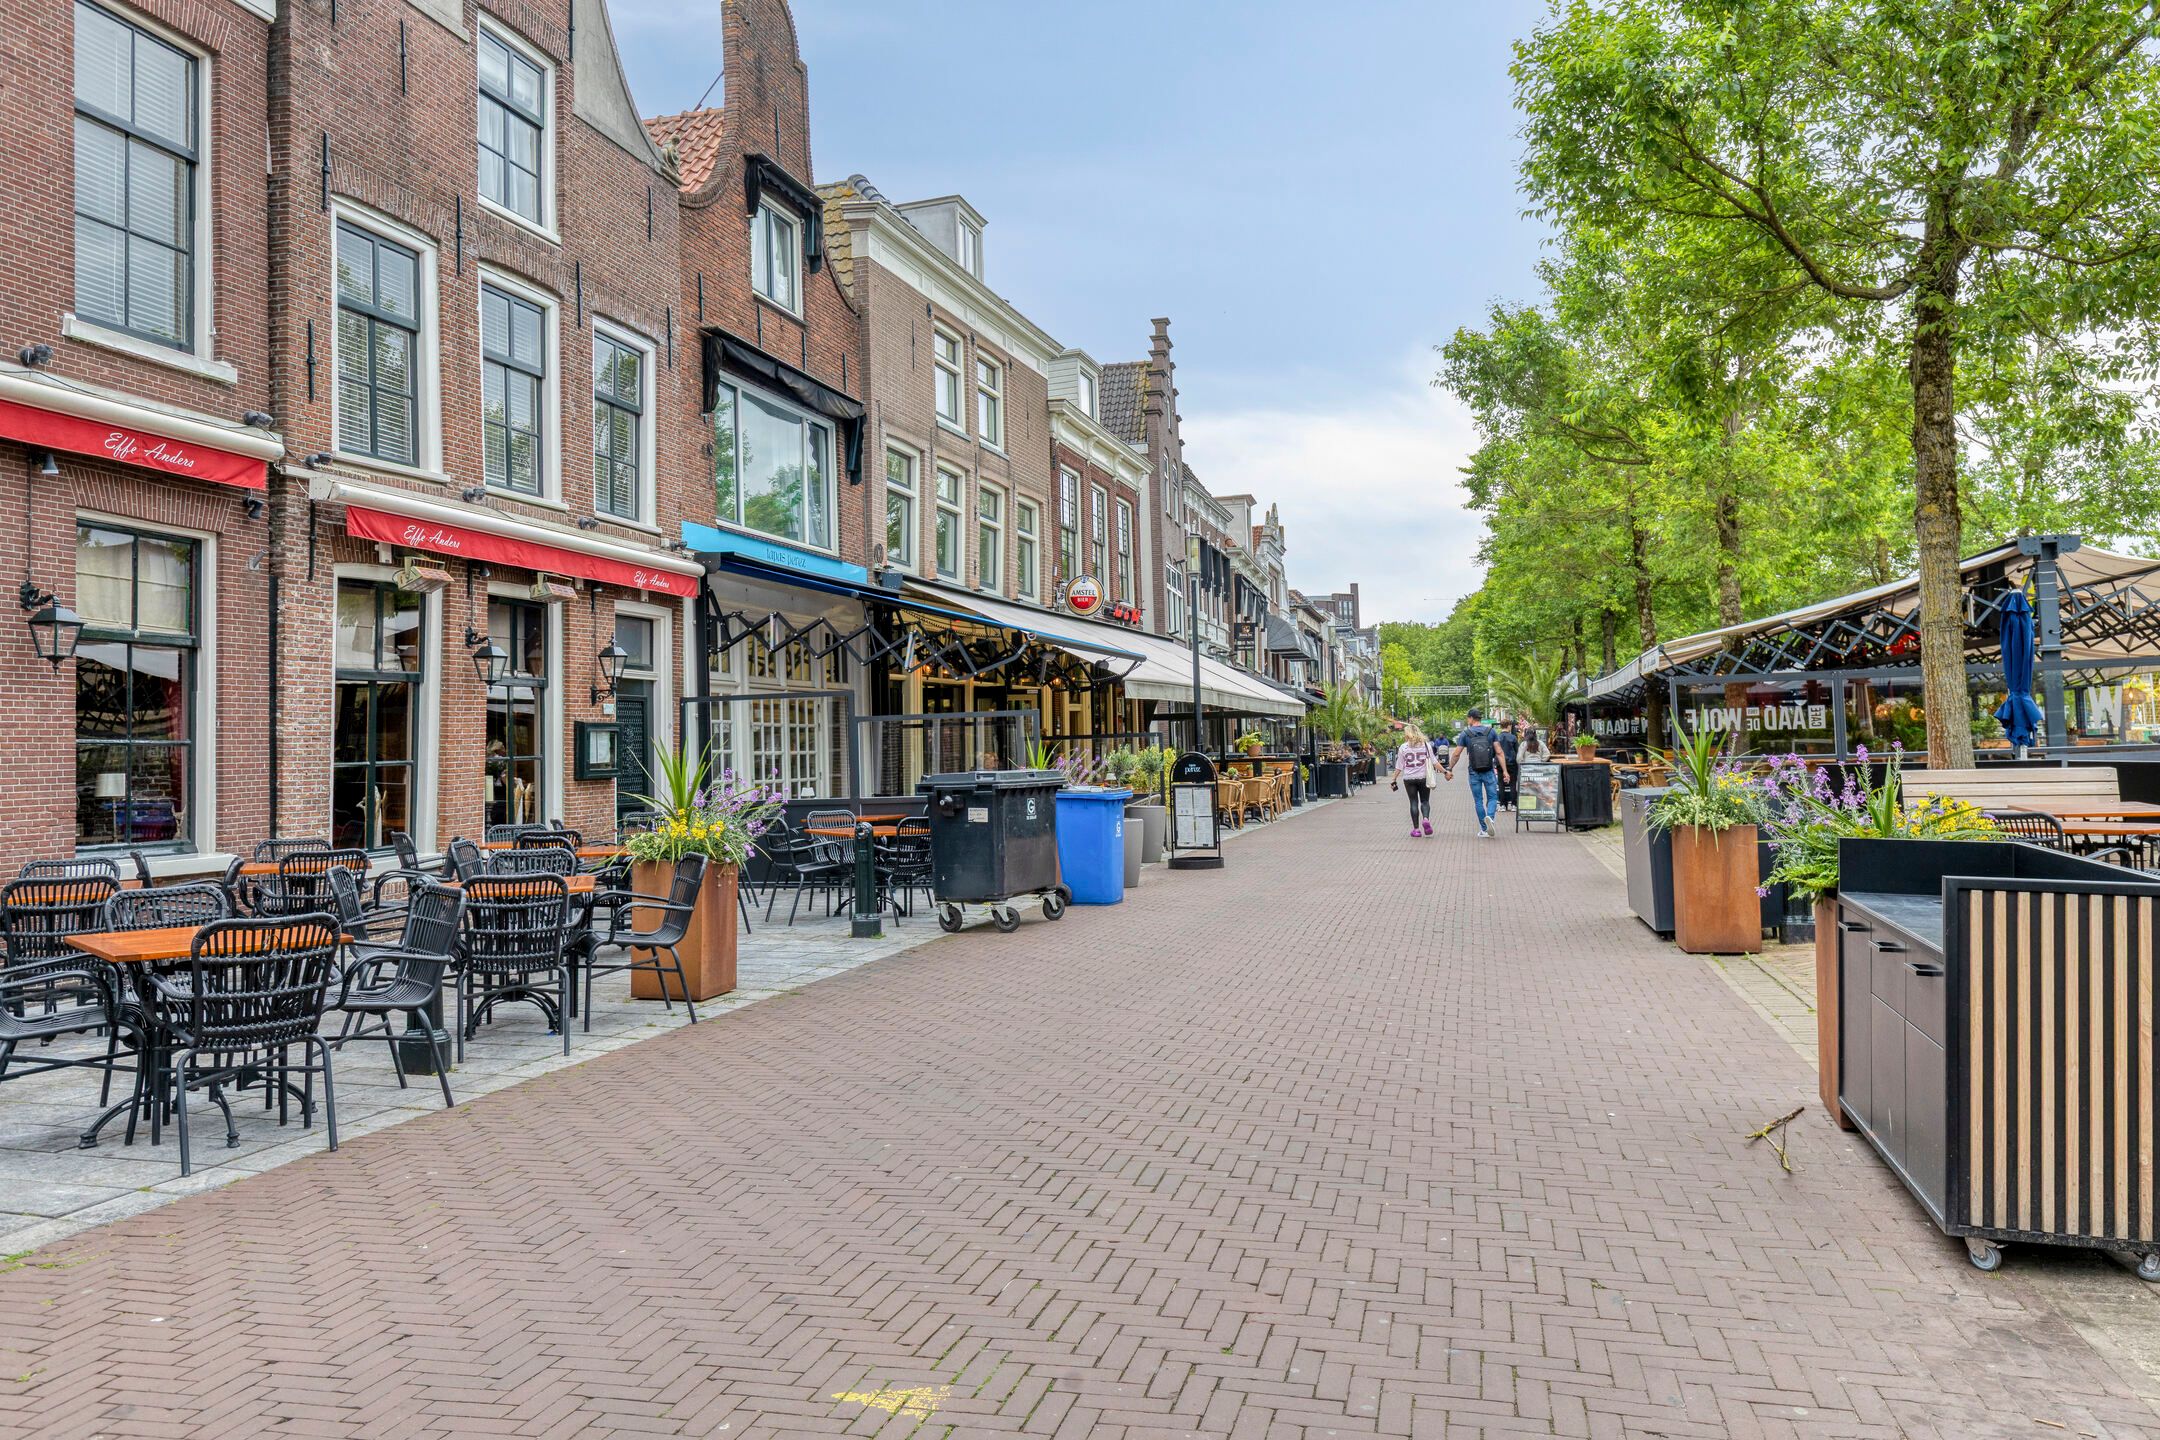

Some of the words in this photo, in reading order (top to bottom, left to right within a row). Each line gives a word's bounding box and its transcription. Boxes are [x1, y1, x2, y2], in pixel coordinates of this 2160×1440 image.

[104, 432, 137, 459] Effe
[144, 443, 195, 468] Anders
[404, 525, 426, 546] Effe
[429, 530, 460, 548] Anders
[633, 570, 647, 588] Effe
[650, 574, 670, 588] Anders
[1405, 752, 1427, 768] 25
